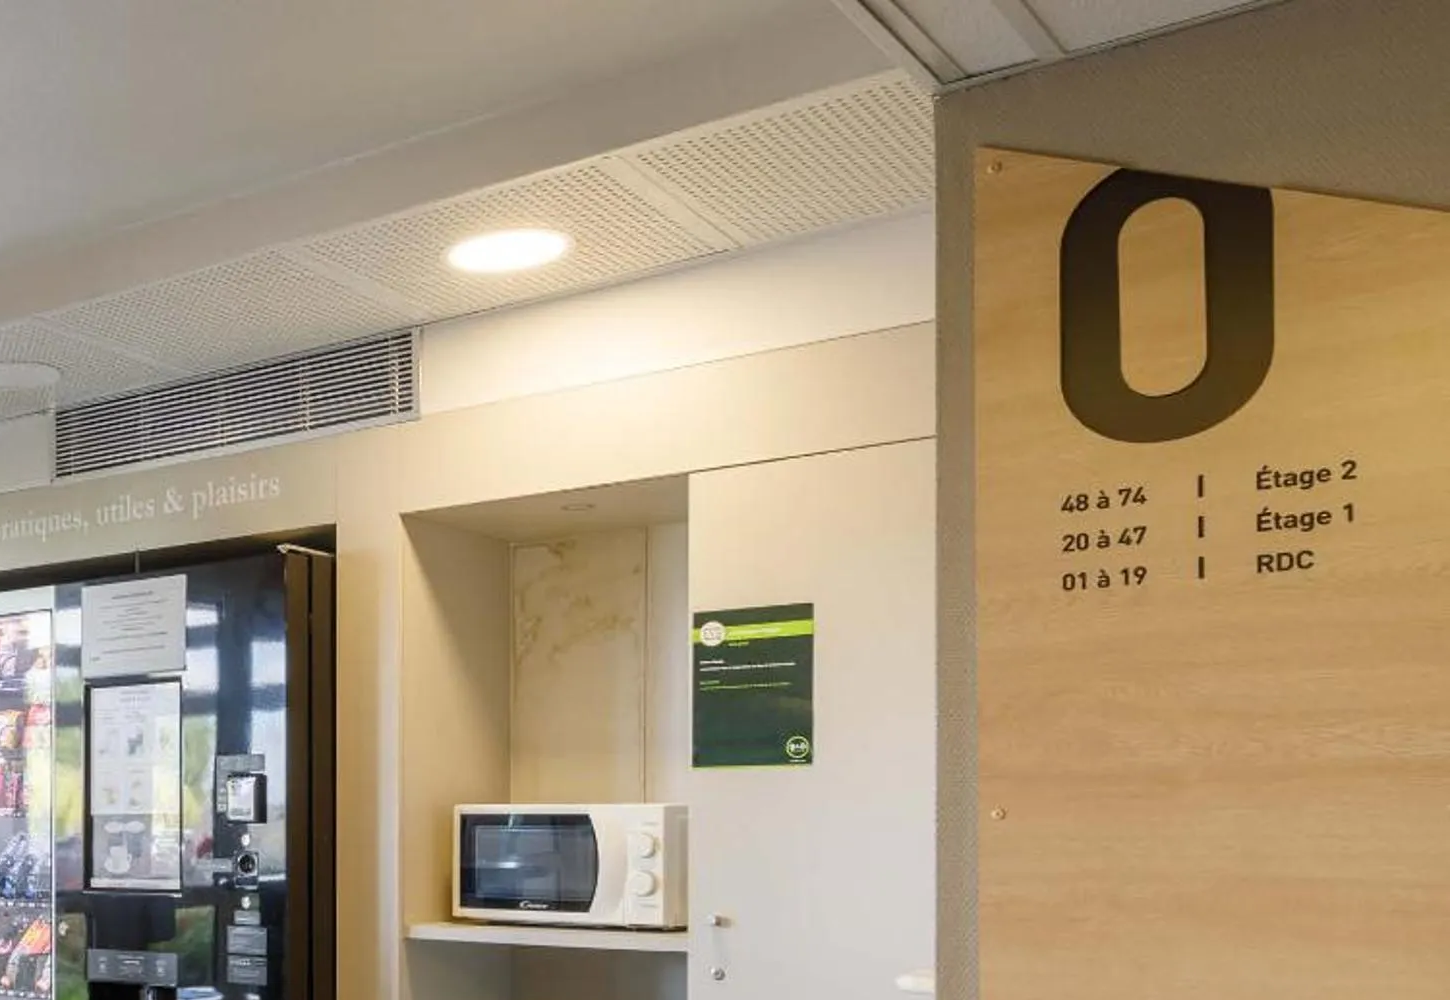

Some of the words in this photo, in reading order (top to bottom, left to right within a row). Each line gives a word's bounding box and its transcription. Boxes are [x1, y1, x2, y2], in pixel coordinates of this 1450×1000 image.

[96, 495, 155, 526] utiles
[162, 486, 184, 515] &
[191, 473, 281, 520] plaisirs
[1060, 494, 1090, 513] 48
[1095, 489, 1111, 510] à
[1117, 486, 1147, 506] 74
[1255, 464, 1332, 492] Étage
[1340, 460, 1358, 481] 2
[1061, 533, 1090, 553] 20
[1096, 529, 1111, 549] à
[1117, 526, 1147, 546] 47
[1255, 507, 1332, 533] Étage
[1342, 503, 1355, 523] 1
[1061, 573, 1088, 592] 01
[1096, 568, 1111, 588] à
[1121, 566, 1147, 586] 19
[1255, 550, 1315, 574] RDC
